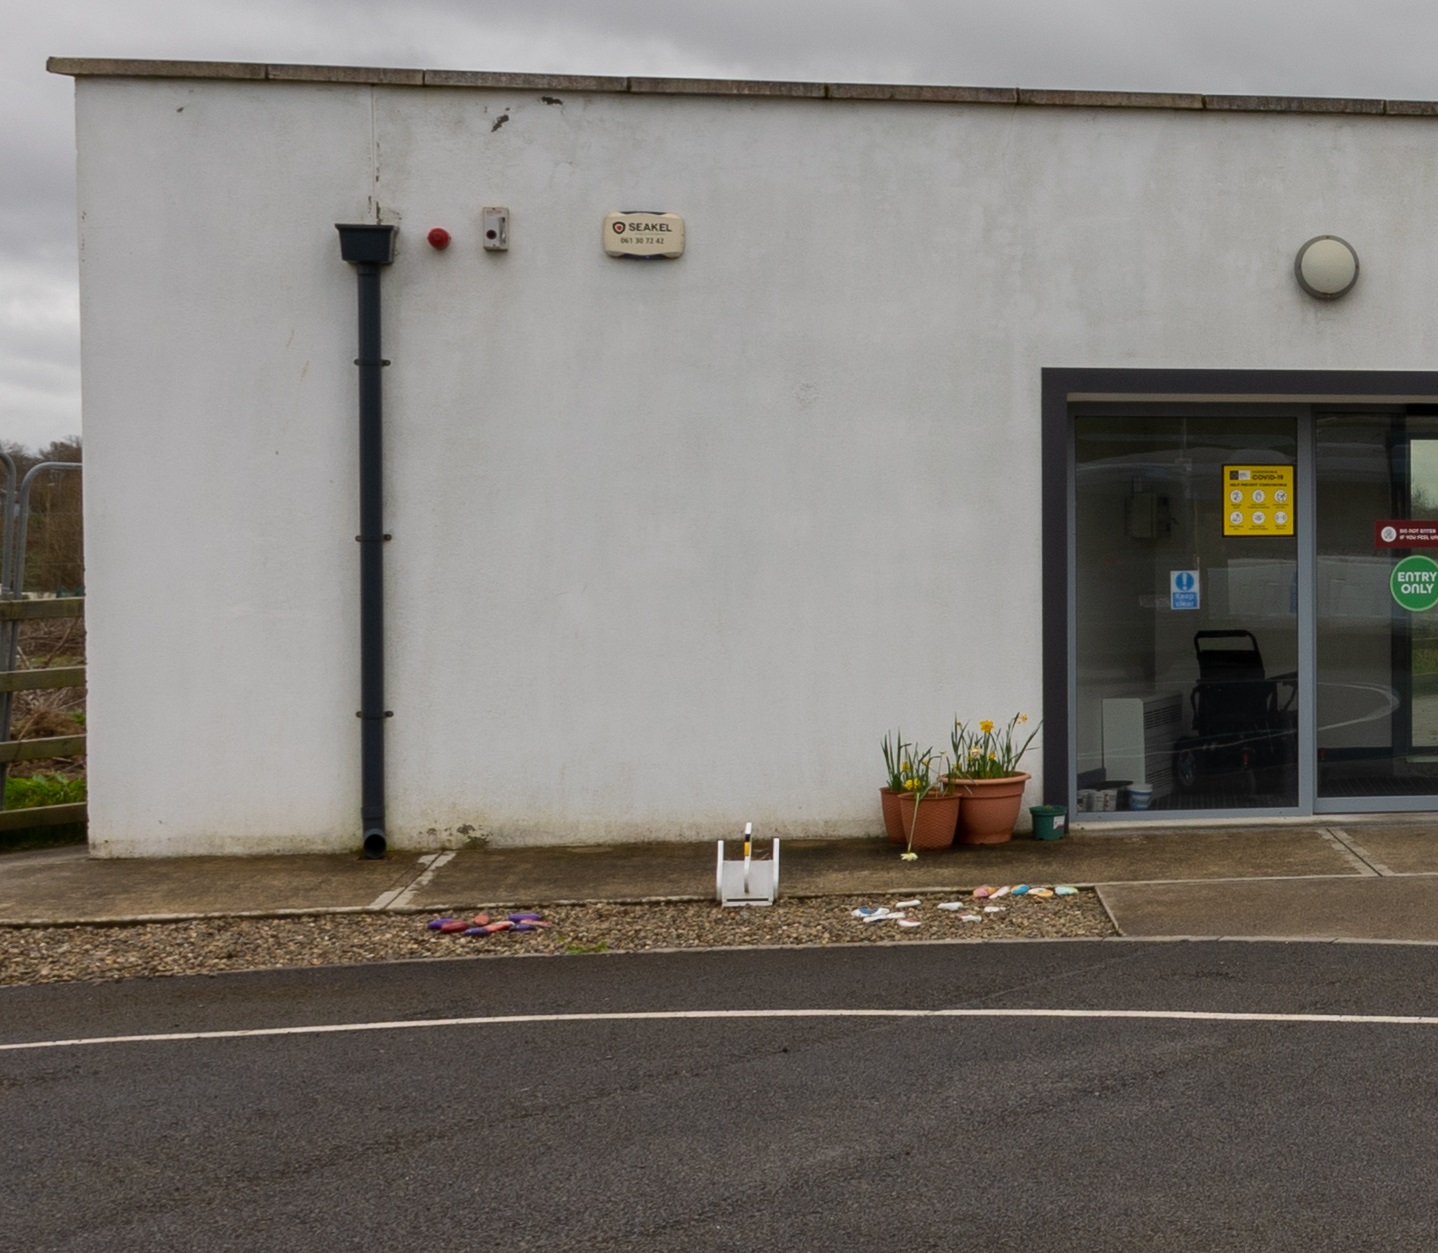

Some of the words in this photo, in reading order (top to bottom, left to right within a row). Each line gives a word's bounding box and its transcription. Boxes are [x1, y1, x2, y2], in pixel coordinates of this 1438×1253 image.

[628, 222, 672, 232] SEAKEL
[1397, 571, 1438, 582] ENTRY
[1400, 583, 1434, 594] ONLY
